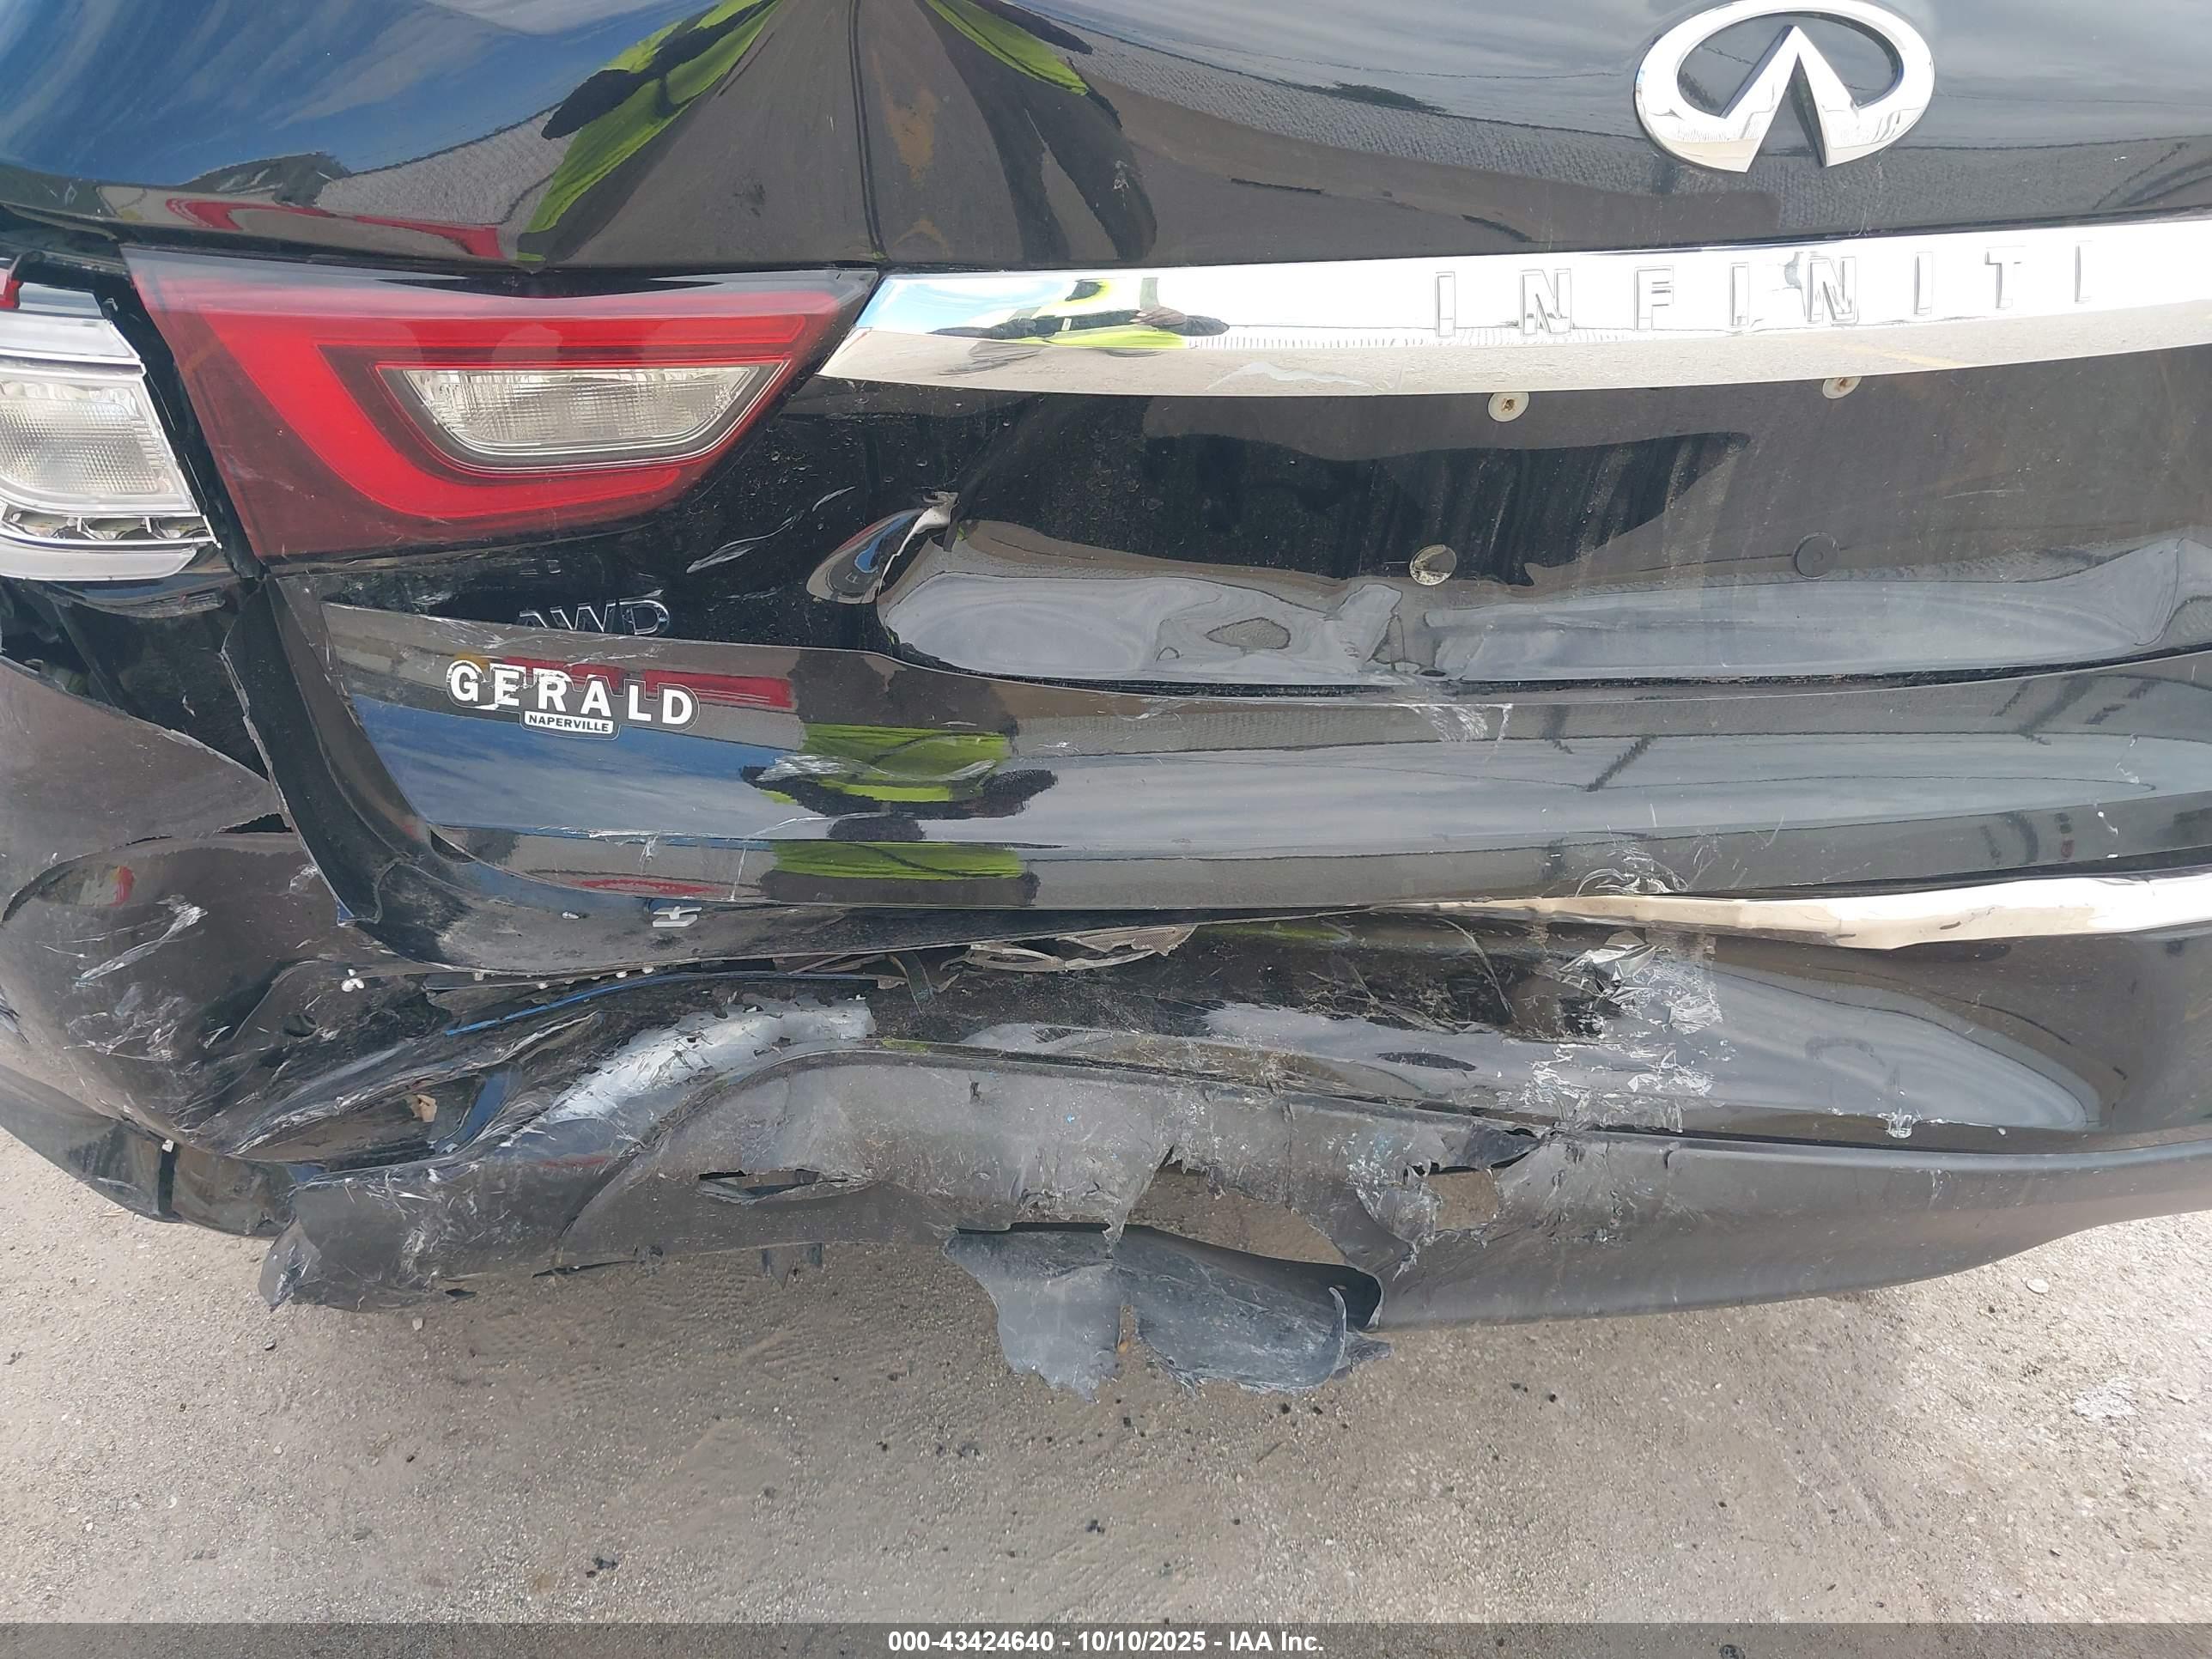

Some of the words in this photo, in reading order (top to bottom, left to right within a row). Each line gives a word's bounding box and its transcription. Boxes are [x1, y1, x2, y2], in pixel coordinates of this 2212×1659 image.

[1435, 240, 2094, 337] INFINITI
[450, 663, 693, 726] GERALD
[528, 714, 610, 732] NAPERVILLE
